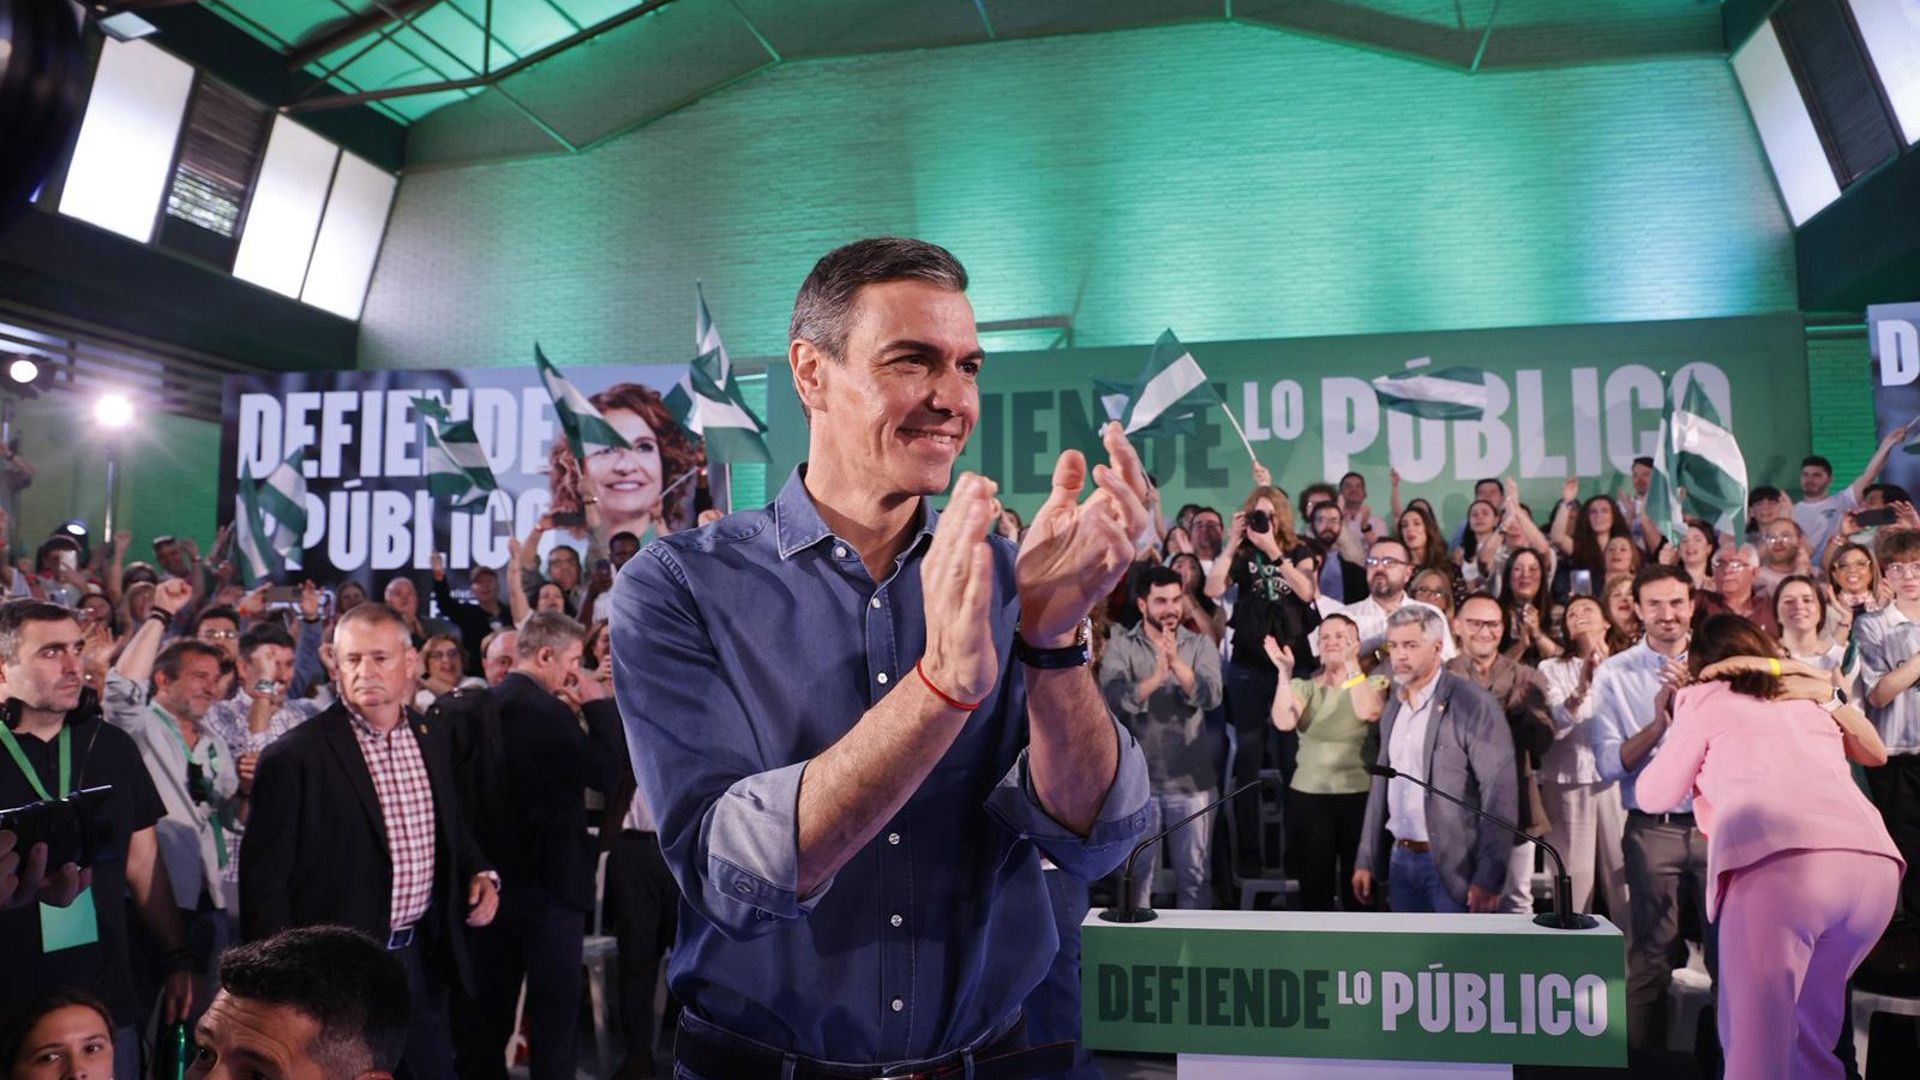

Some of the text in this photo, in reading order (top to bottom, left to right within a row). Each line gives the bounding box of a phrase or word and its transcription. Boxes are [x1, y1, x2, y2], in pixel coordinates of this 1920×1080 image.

[1243, 379, 1304, 440] LO
[1099, 963, 1608, 1037] DEFIENDE LO PÚBLICO
